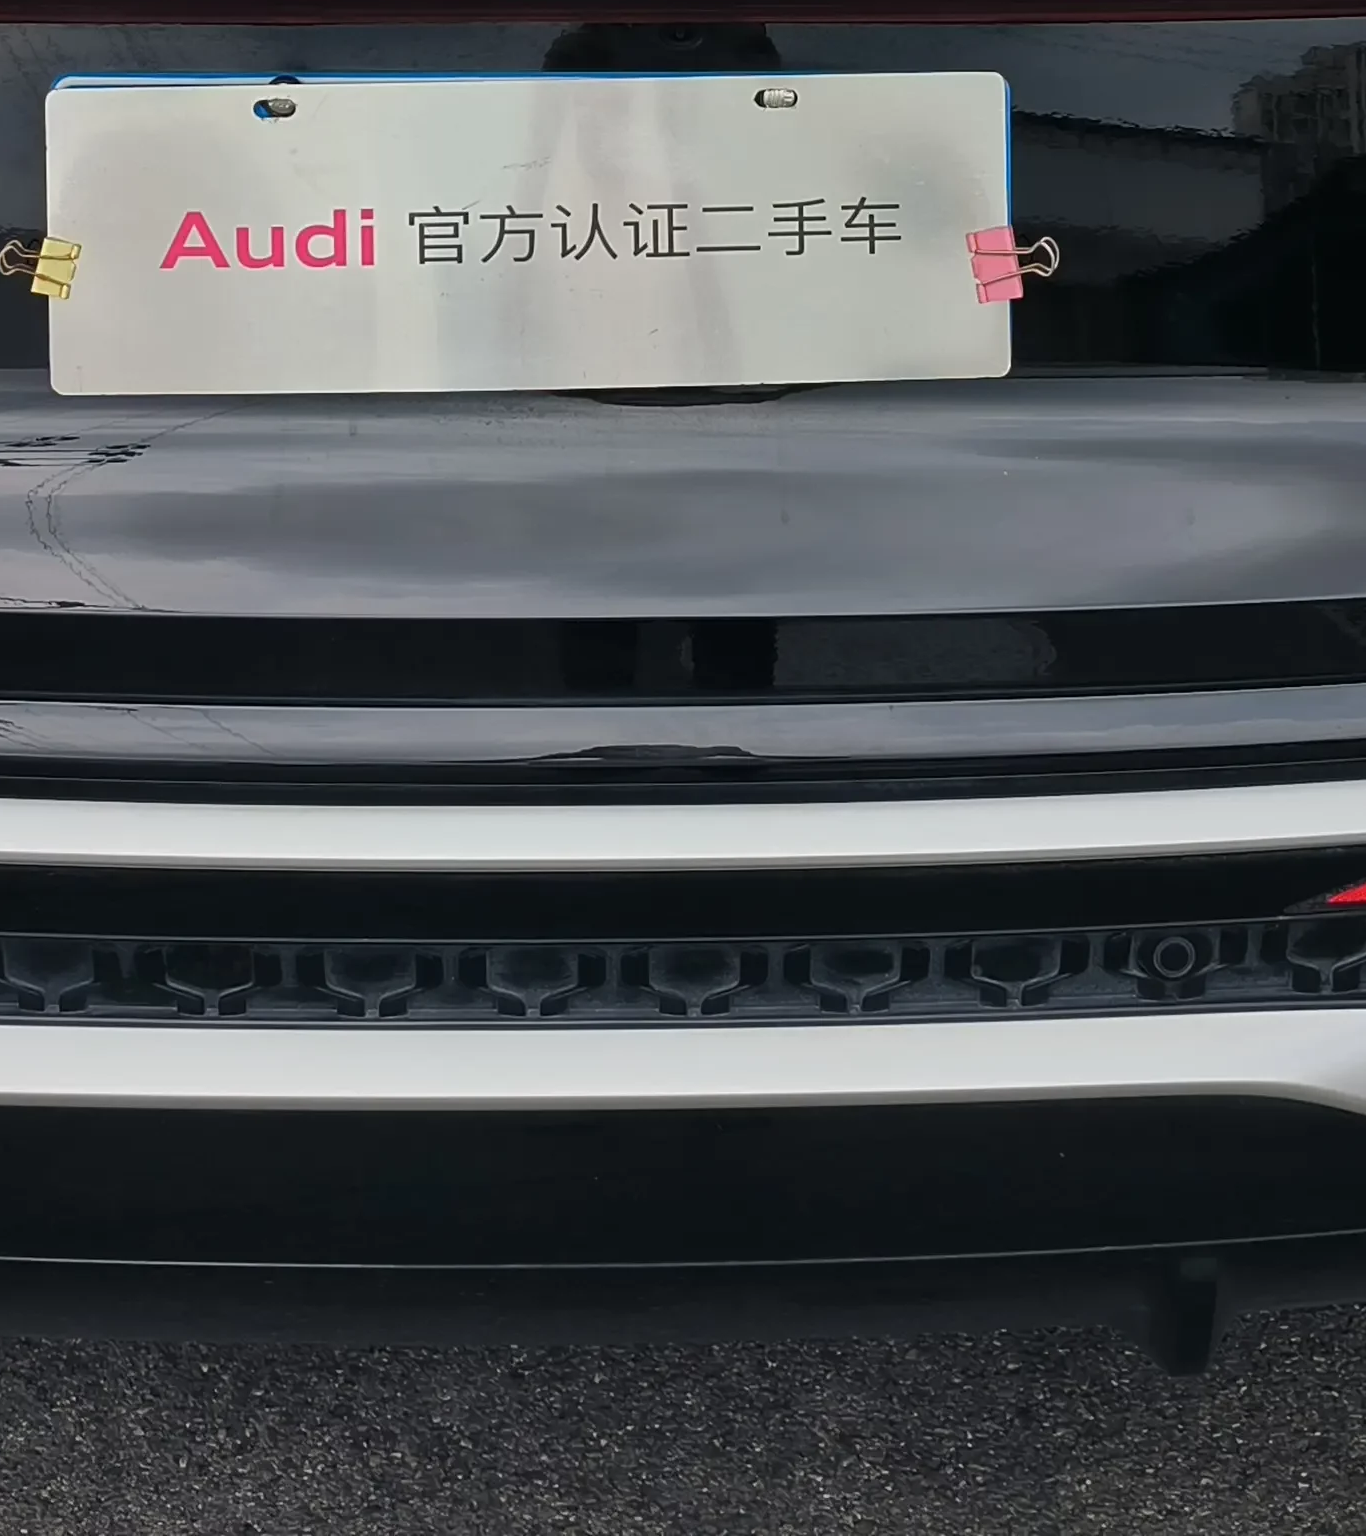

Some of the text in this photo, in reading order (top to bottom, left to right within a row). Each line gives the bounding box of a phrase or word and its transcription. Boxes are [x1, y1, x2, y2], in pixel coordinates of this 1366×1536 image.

[160, 196, 903, 271] Audi 官方认证二手车
